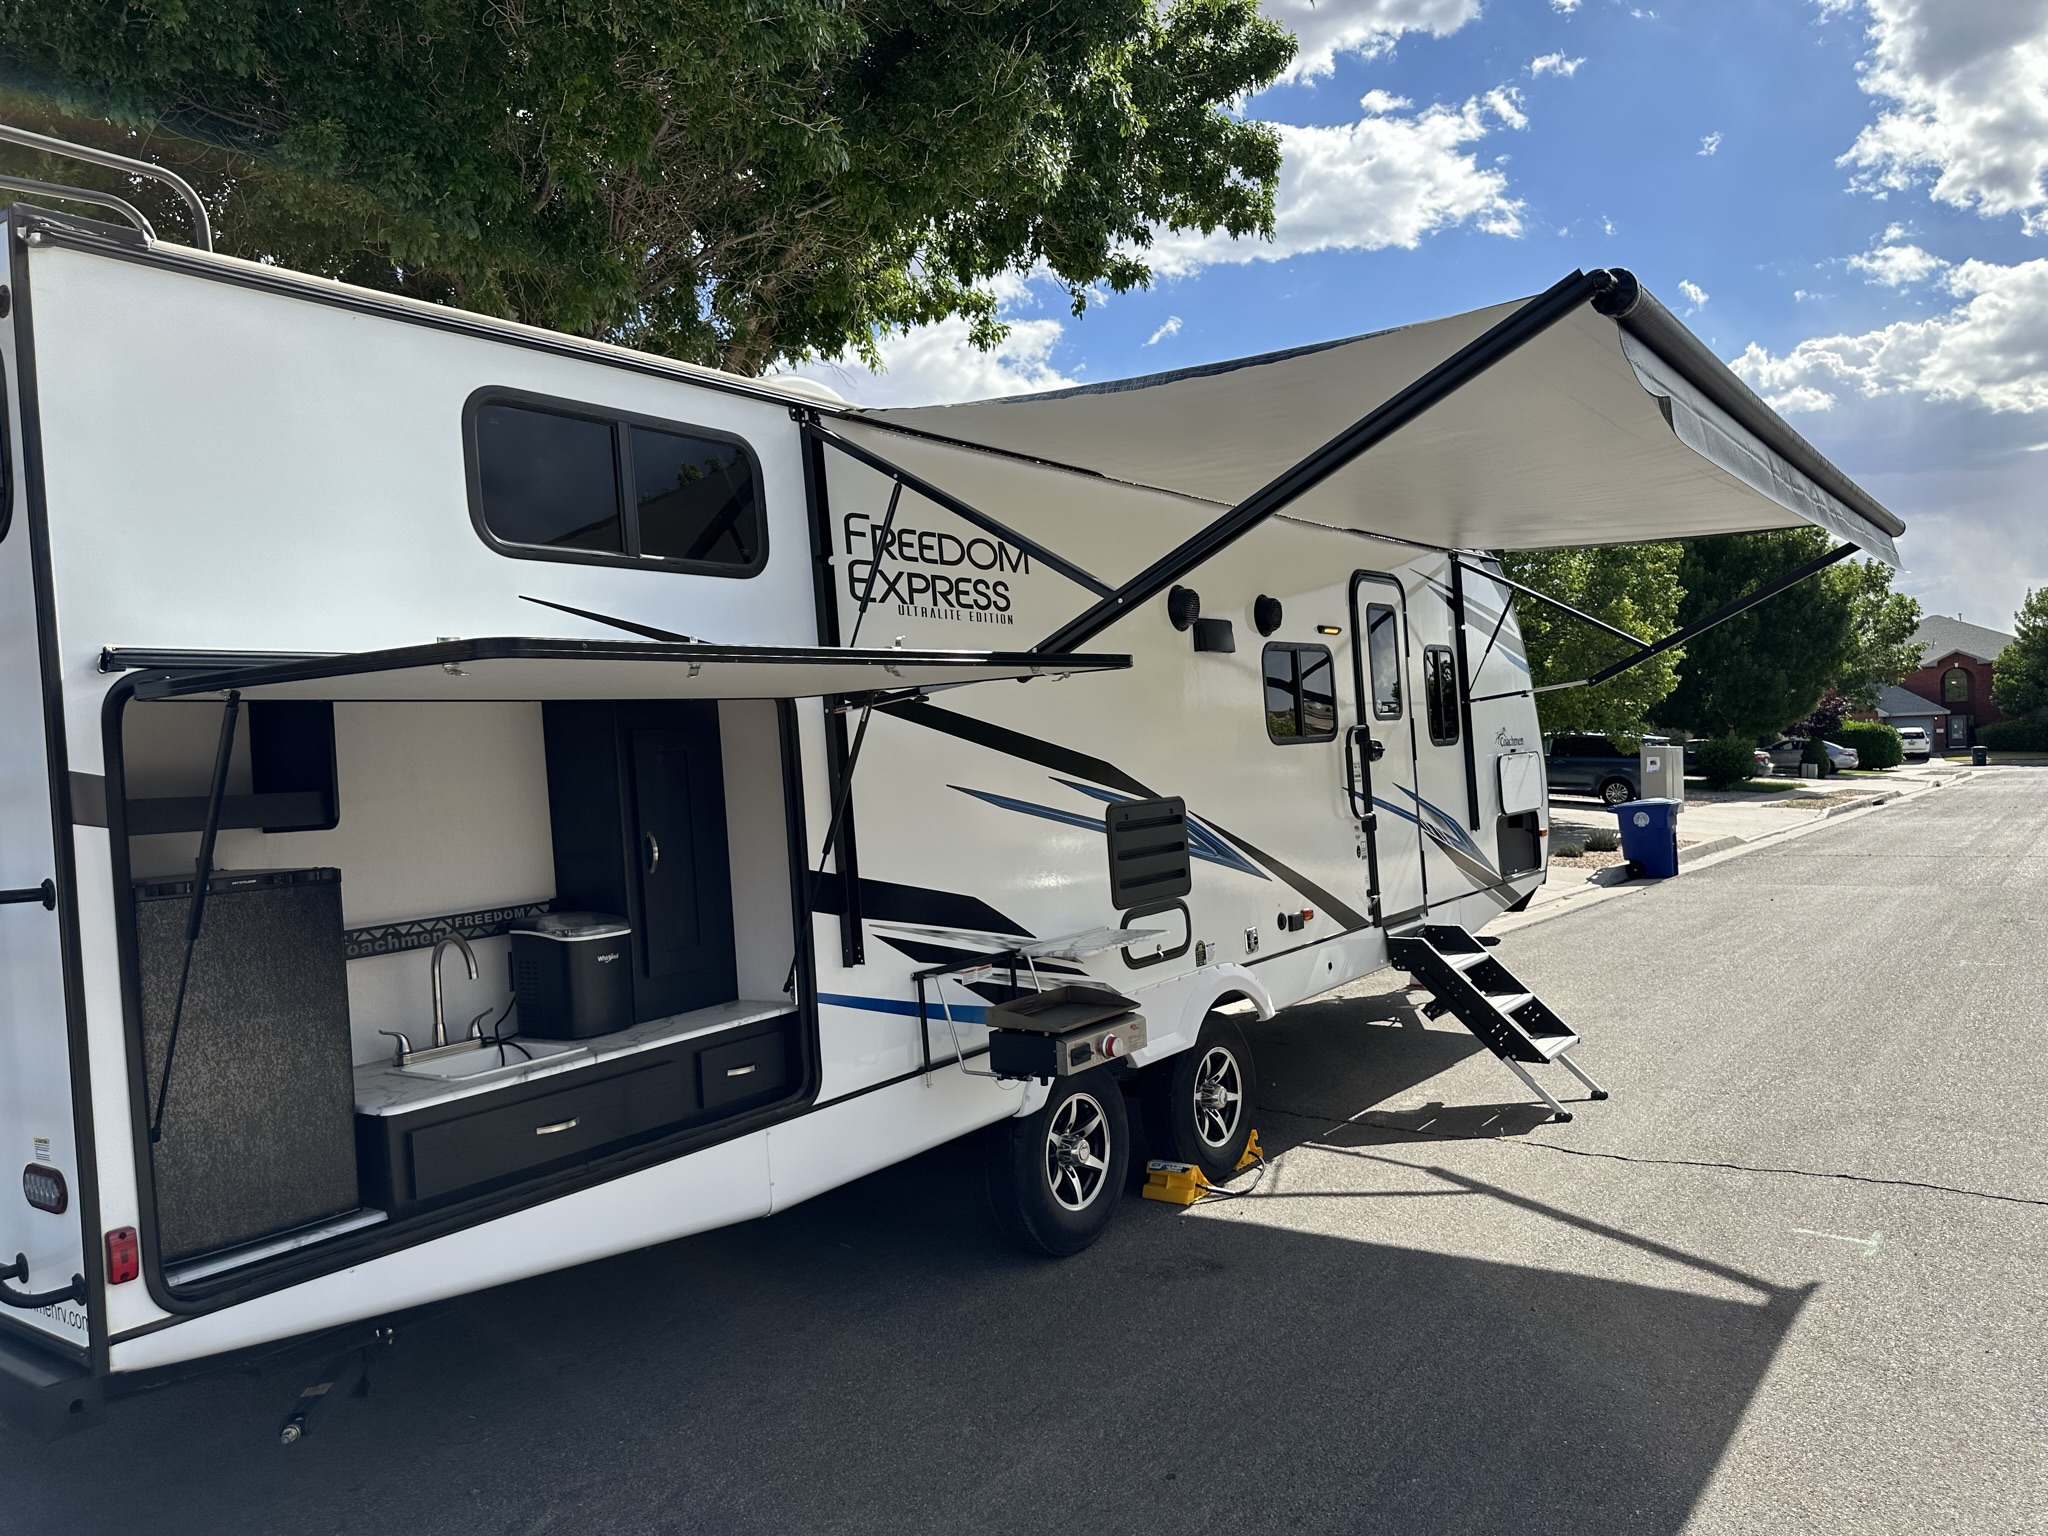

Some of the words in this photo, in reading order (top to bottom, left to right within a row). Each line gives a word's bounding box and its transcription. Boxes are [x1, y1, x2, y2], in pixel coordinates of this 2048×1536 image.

[843, 512, 1030, 575] FREEDOM
[847, 559, 1012, 612] EXPRESS
[898, 604, 962, 621] ULTRALITE
[969, 611, 1013, 625] EDITION
[455, 908, 525, 928] FREEDOM
[345, 931, 444, 956] oachmen
